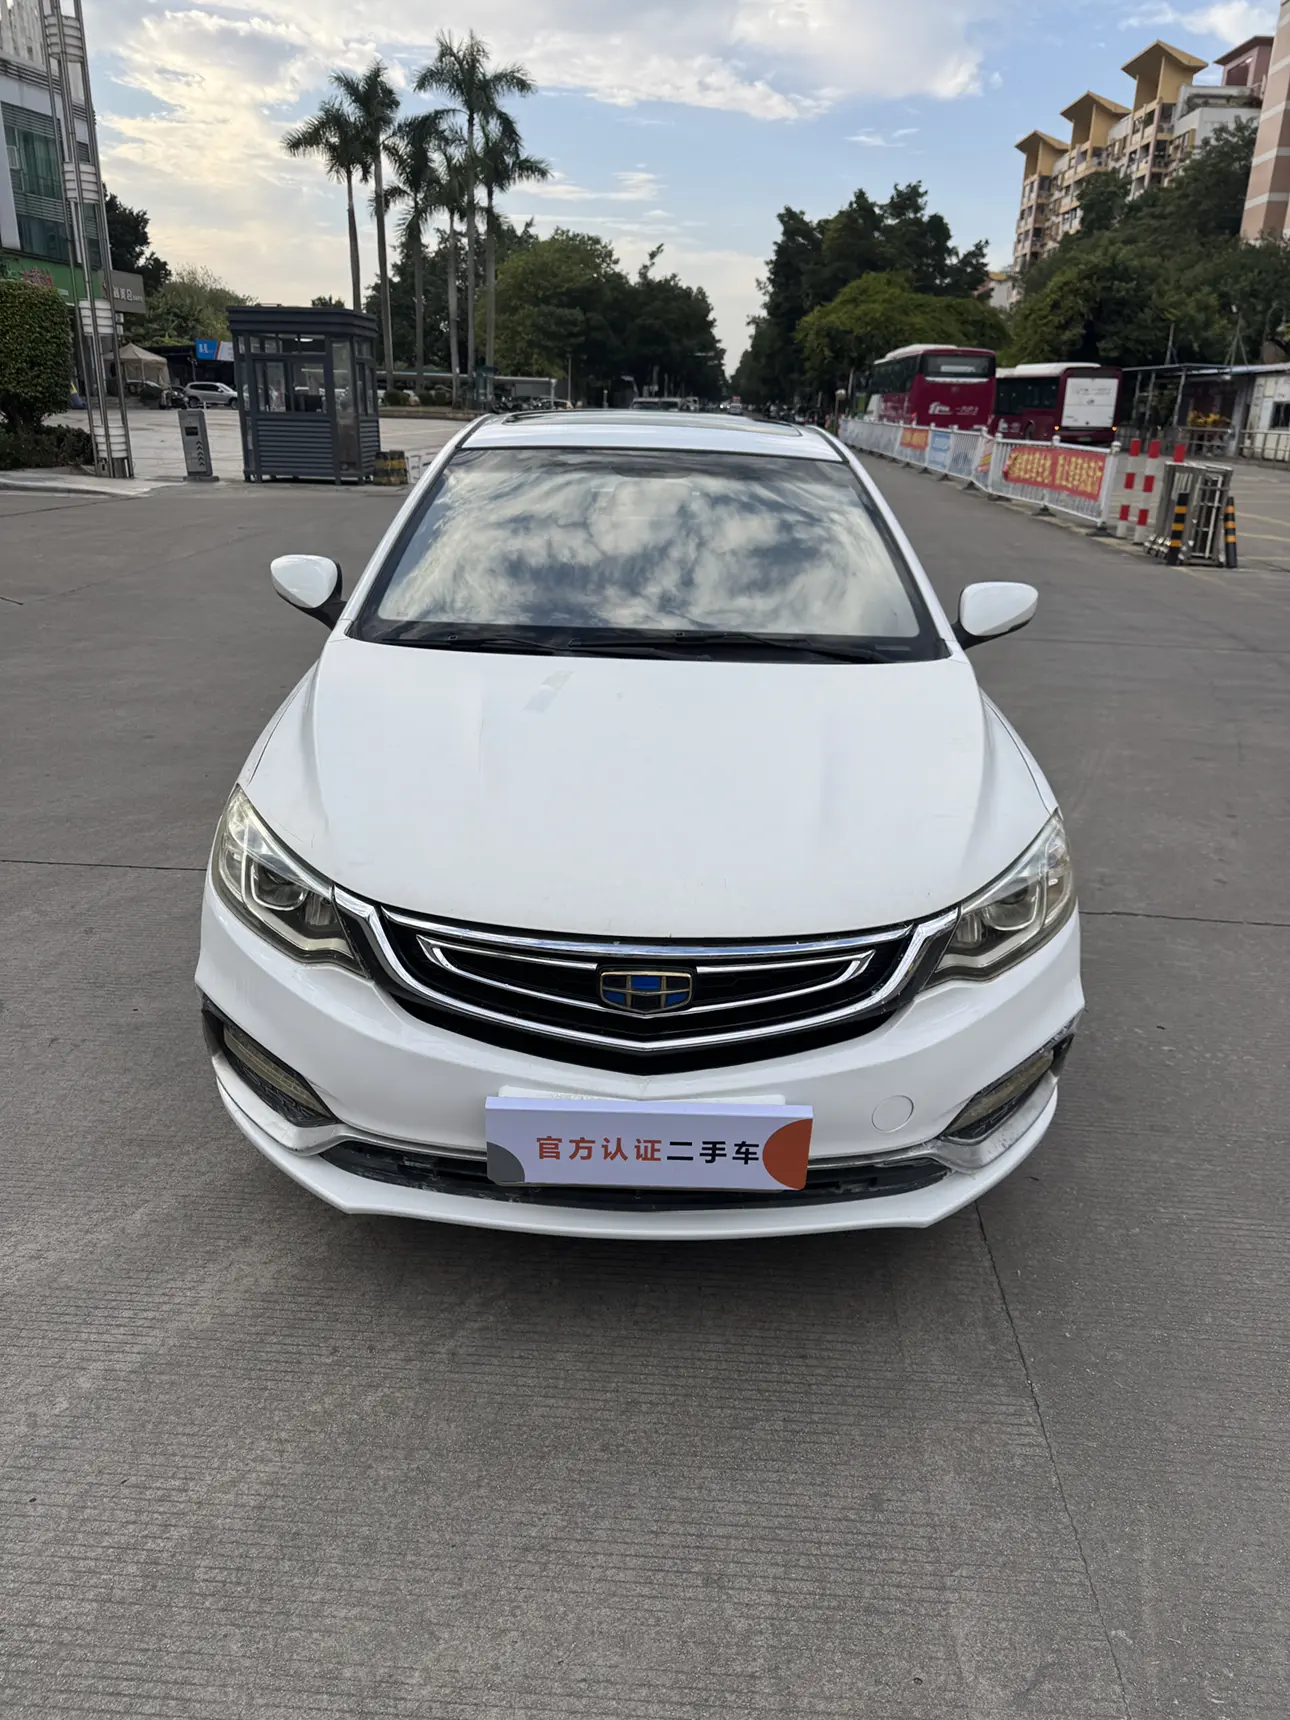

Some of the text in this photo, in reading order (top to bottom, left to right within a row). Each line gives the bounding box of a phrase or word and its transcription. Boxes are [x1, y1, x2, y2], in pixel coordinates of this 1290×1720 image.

[536, 1135, 760, 1165] 官方认证二手车
